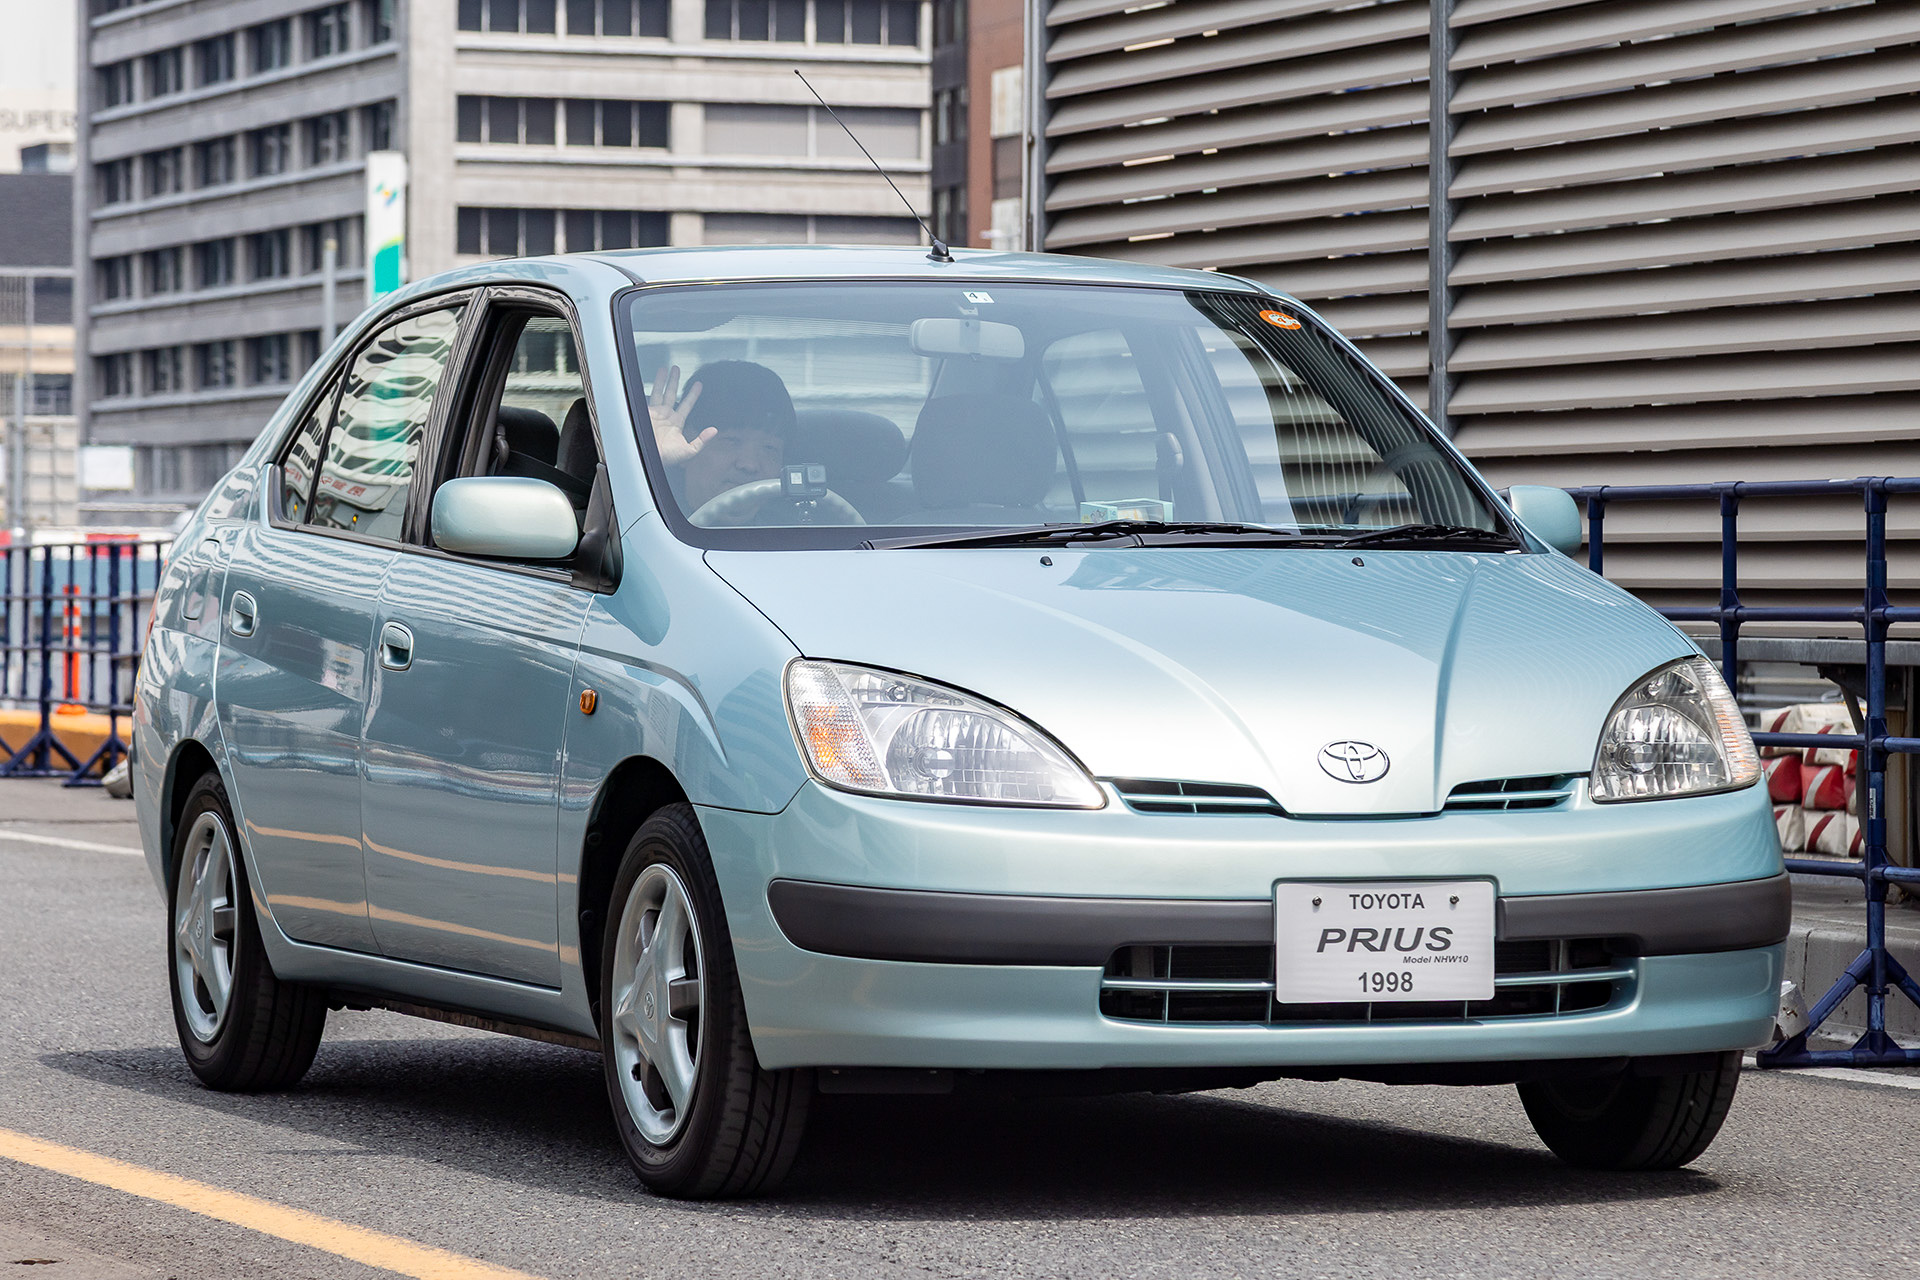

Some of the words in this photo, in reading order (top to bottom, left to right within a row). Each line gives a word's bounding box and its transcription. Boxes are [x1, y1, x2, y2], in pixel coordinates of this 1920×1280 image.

[1349, 893, 1425, 910] TOYOTA
[1316, 927, 1454, 953] PRIUS
[1402, 955, 1432, 964] Model
[1433, 955, 1469, 963] NHW10
[1358, 971, 1413, 993] 1998
